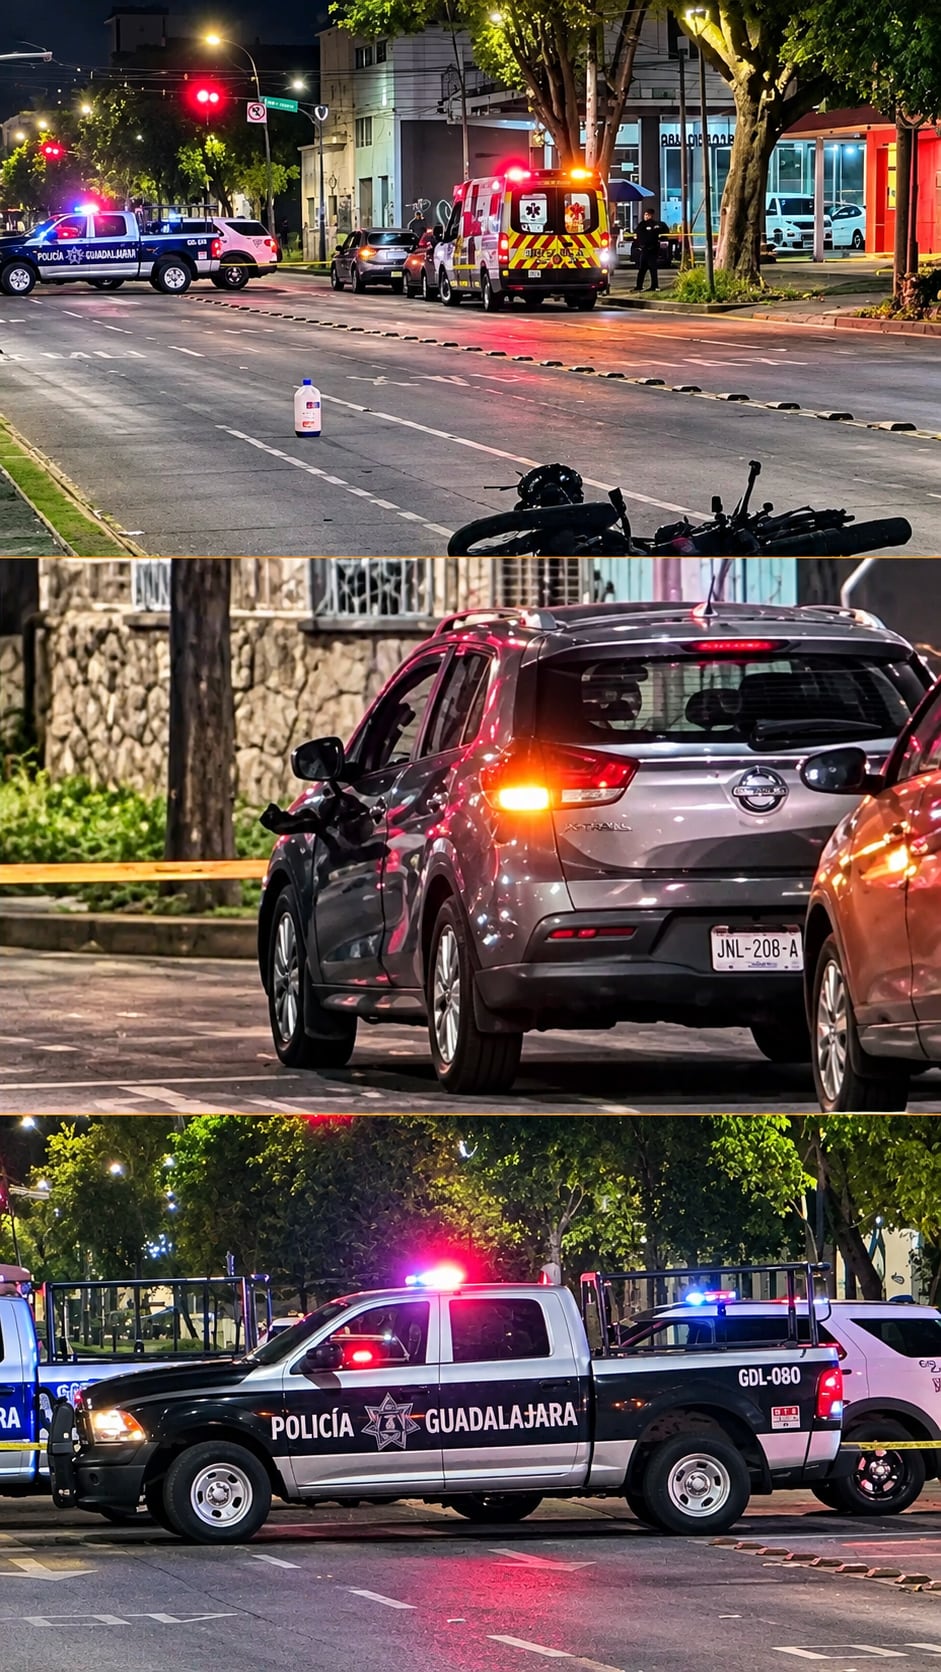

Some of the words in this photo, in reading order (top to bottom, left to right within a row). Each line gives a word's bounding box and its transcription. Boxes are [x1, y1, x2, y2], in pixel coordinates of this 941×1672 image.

[717, 938, 799, 958] JNL-208-A
[738, 1366, 801, 1387] GDL-080
[271, 1407, 355, 1440] POLICÍA
[425, 1402, 578, 1434] GUADALAJARA
